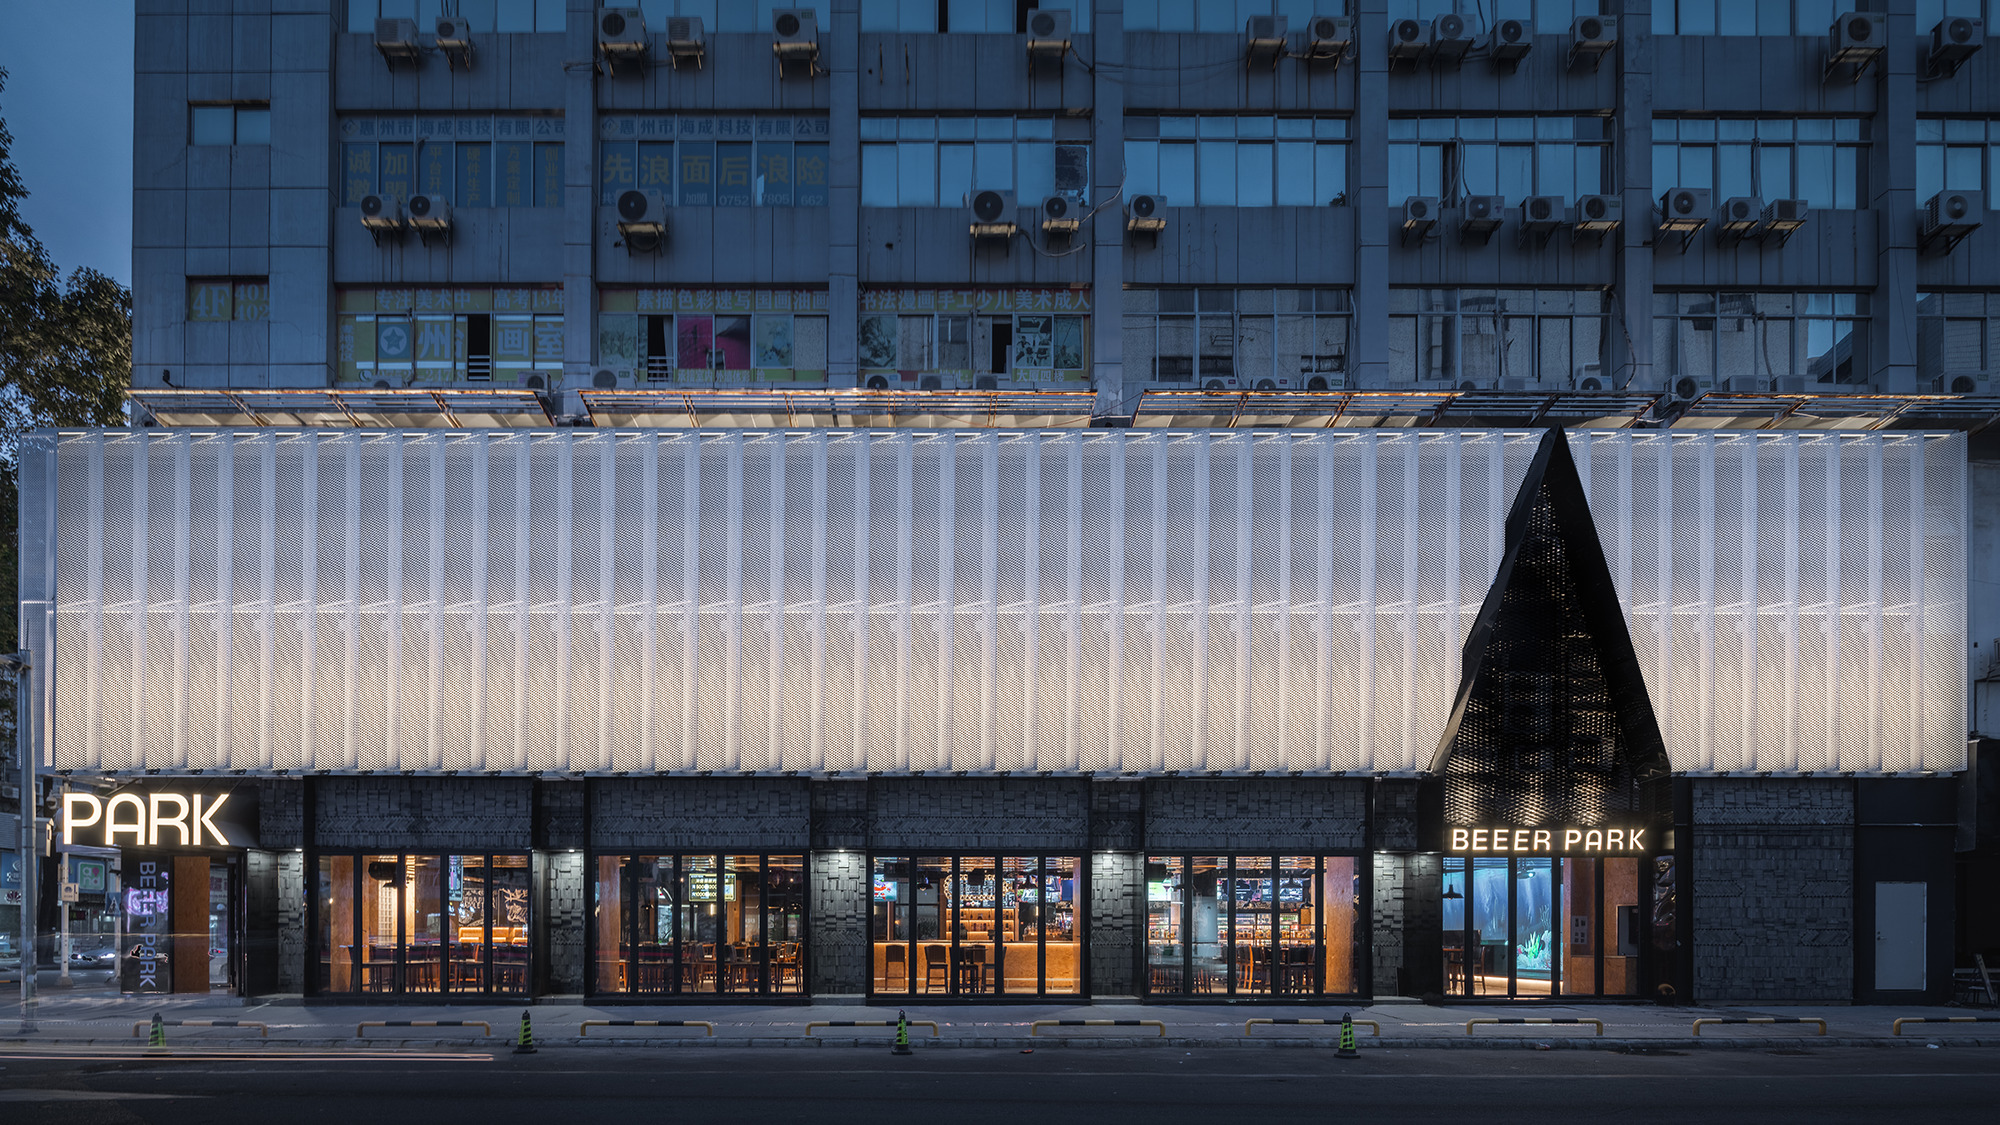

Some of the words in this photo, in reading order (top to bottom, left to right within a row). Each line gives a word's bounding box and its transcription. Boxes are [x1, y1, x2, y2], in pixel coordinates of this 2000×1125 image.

[429, 146, 442, 196] 平台开
[719, 193, 749, 206] 0752
[193, 286, 229, 317] 4F
[235, 283, 268, 301] 401
[637, 290, 829, 310] 素描色彩速写国画油画
[860, 290, 1091, 310] 书法漫画手工少儿美术成人
[235, 303, 269, 320] 402
[63, 792, 230, 845] PARK
[1451, 828, 1552, 852] BEEER
[1564, 828, 1646, 852] PARK
[139, 934, 157, 988] PARK
